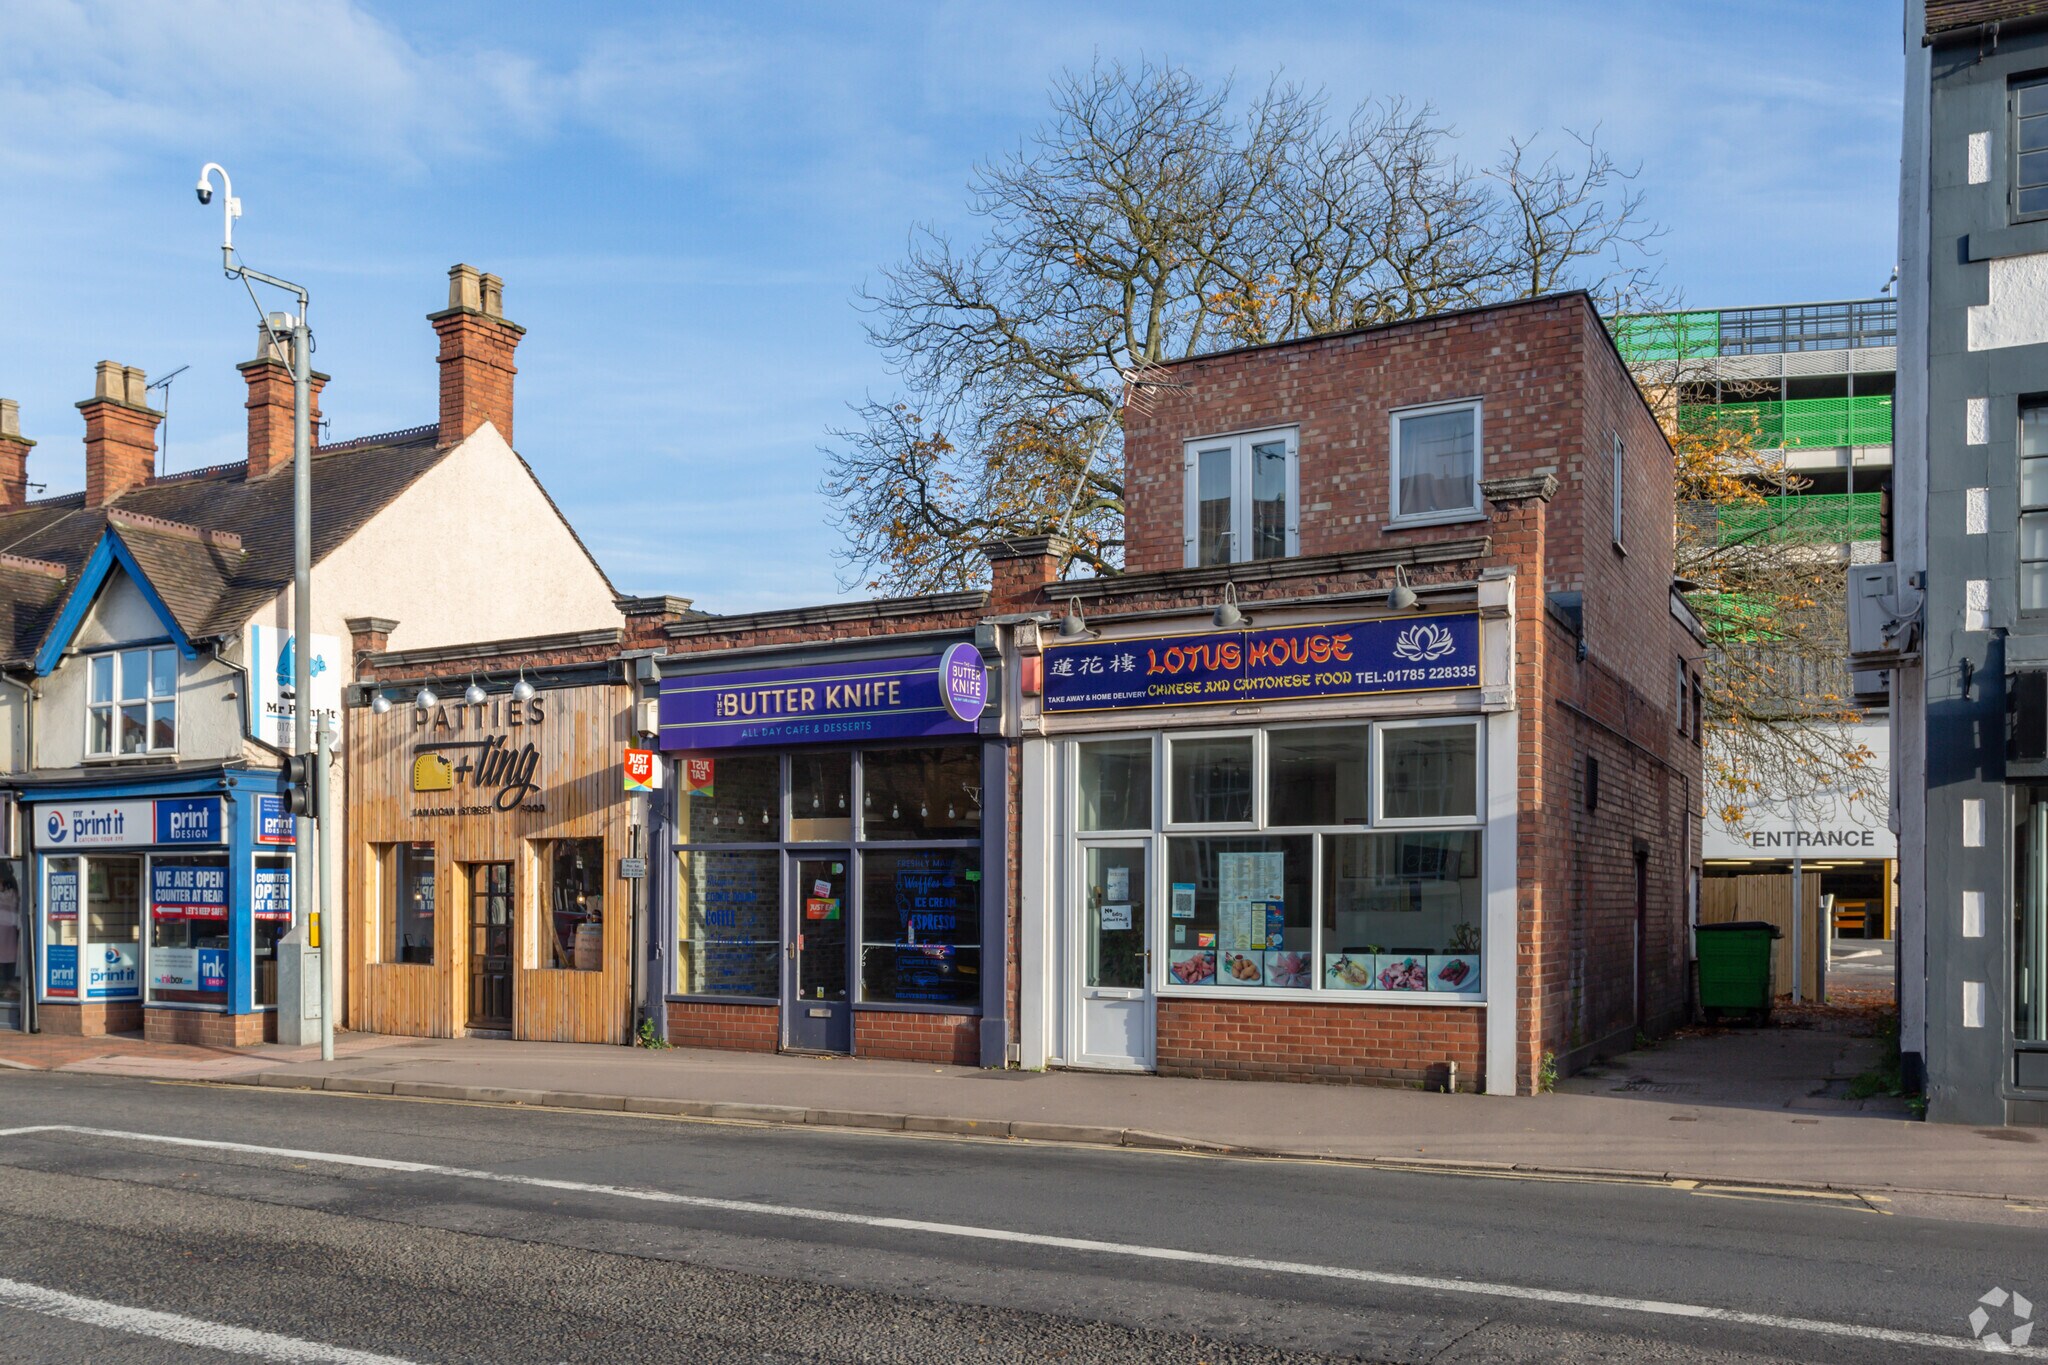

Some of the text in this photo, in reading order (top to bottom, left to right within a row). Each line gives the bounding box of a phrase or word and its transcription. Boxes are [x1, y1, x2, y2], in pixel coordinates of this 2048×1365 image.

[1147, 633, 1353, 676] LOTUS HOUSE
[952, 665, 981, 681] BUTTER
[952, 678, 981, 697] KNIFE
[1148, 665, 1477, 698] CHINESE AND CANTONESE FOOD TEL:01785 228335
[724, 680, 901, 717] BUTTER KNIFE
[1048, 695, 1065, 703] TAKE
[1066, 694, 1085, 703] AWAY
[1092, 692, 1112, 701] HOME
[1113, 690, 1147, 700] DELIVERY
[266, 702, 285, 714] Mr
[415, 697, 545, 733] PATTIES
[742, 721, 872, 738] ALL DAY CAFE & DESSERTS
[629, 753, 649, 765] JUST
[632, 764, 649, 775] EAT
[73, 810, 83, 818] mr
[413, 804, 546, 817] JAMAICAN STREET FOOD
[74, 809, 124, 843] print it
[171, 804, 209, 839] print
[264, 814, 293, 833] print
[176, 829, 208, 839] DESIGN
[1753, 831, 1875, 847] ENTRANCE
[155, 871, 224, 888] WE ARE OPEN
[256, 873, 289, 883] COUNTER
[51, 885, 77, 901] OPEN
[155, 889, 224, 903] COUNTER AT REAR
[255, 883, 290, 900] OPEN
[255, 900, 290, 910] AT REAR
[915, 897, 957, 908] ICE CREAM
[202, 955, 225, 977] ink
[51, 964, 74, 986] print
[90, 967, 136, 985] print it
[208, 978, 224, 986] SHOP
